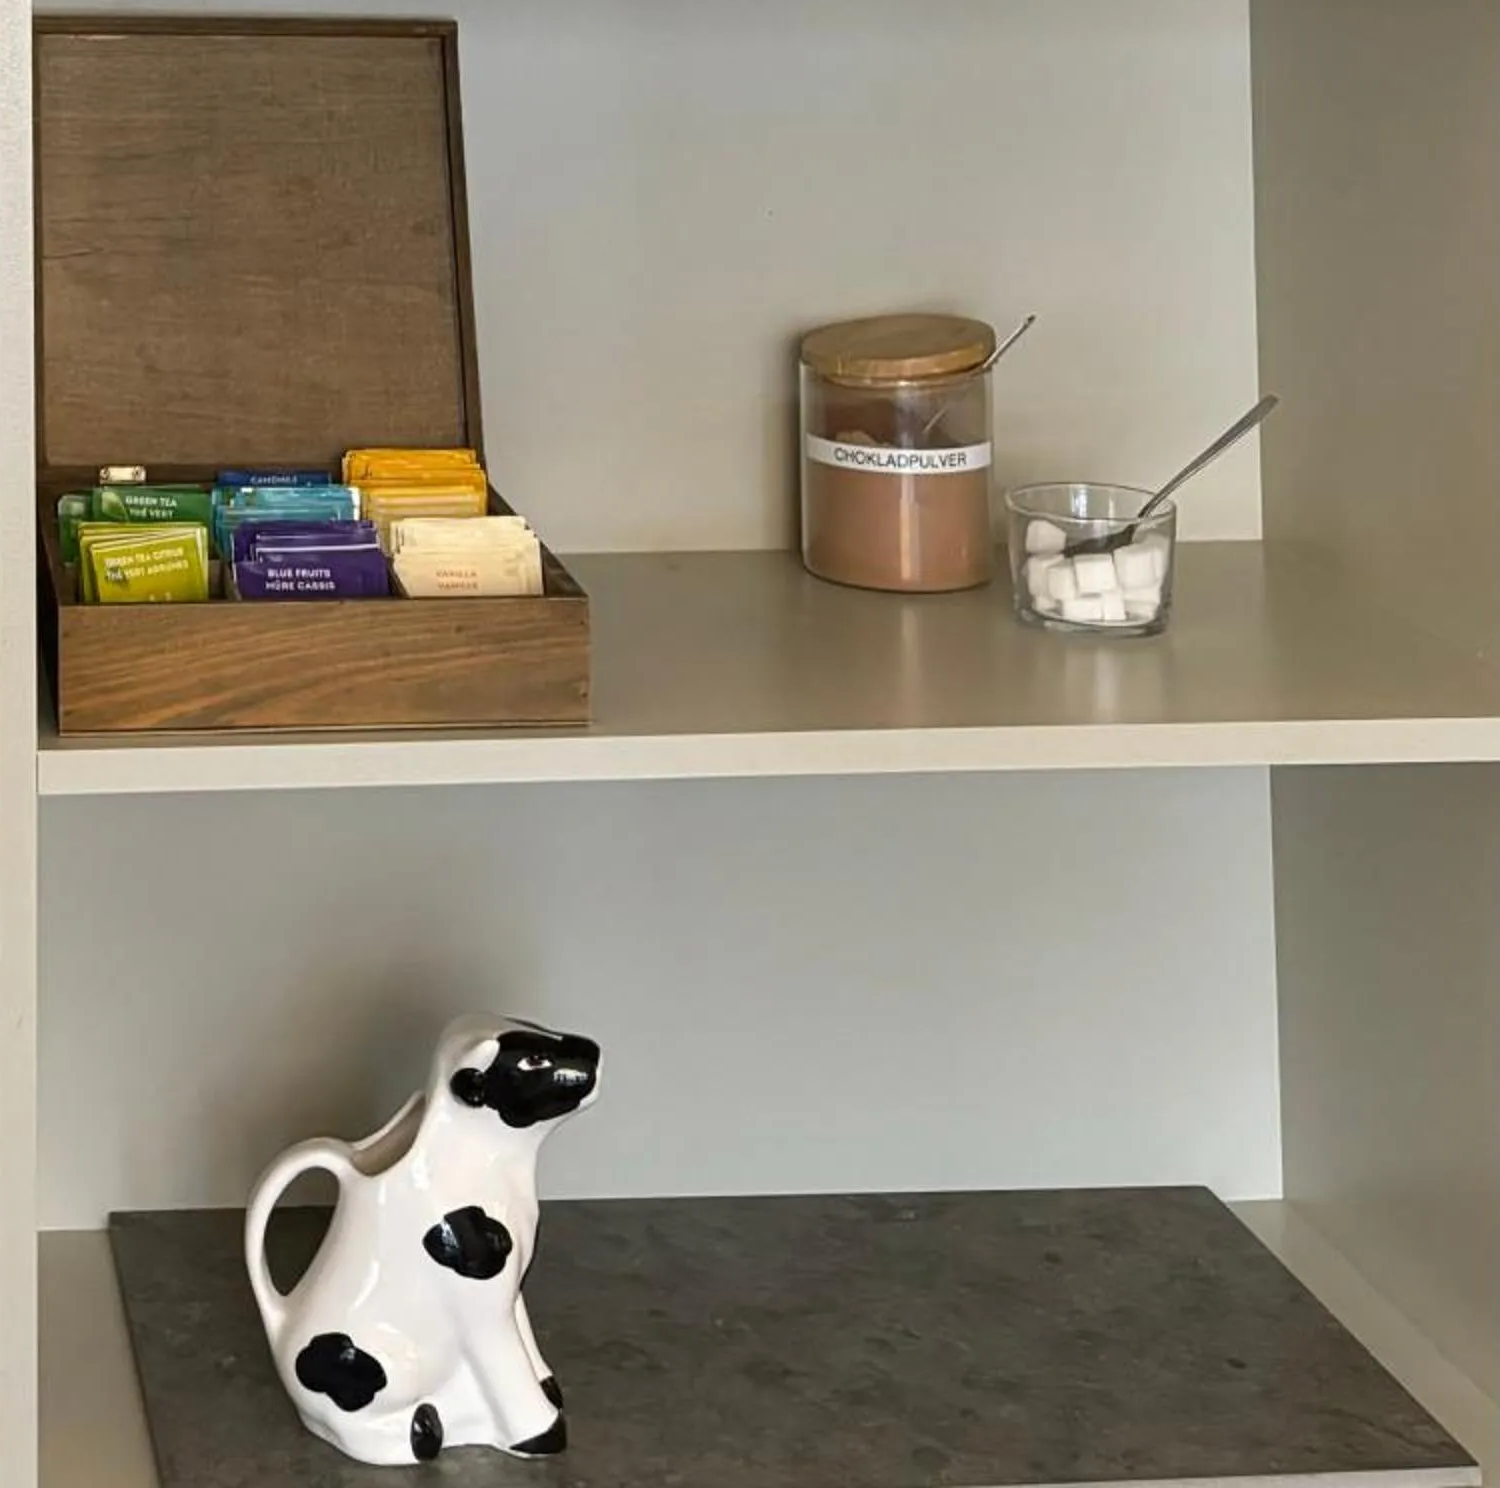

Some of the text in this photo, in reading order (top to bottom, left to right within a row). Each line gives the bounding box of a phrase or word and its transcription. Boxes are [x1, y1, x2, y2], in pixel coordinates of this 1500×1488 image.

[834, 447, 967, 469] CHOKLADPULVER
[125, 496, 177, 507] GREEN TEA
[104, 555, 133, 567] GREEN
[136, 553, 150, 562] TEA
[124, 567, 145, 579] VERT
[267, 568, 331, 578] BLUE FRUITS
[297, 581, 336, 591] CASSIS
